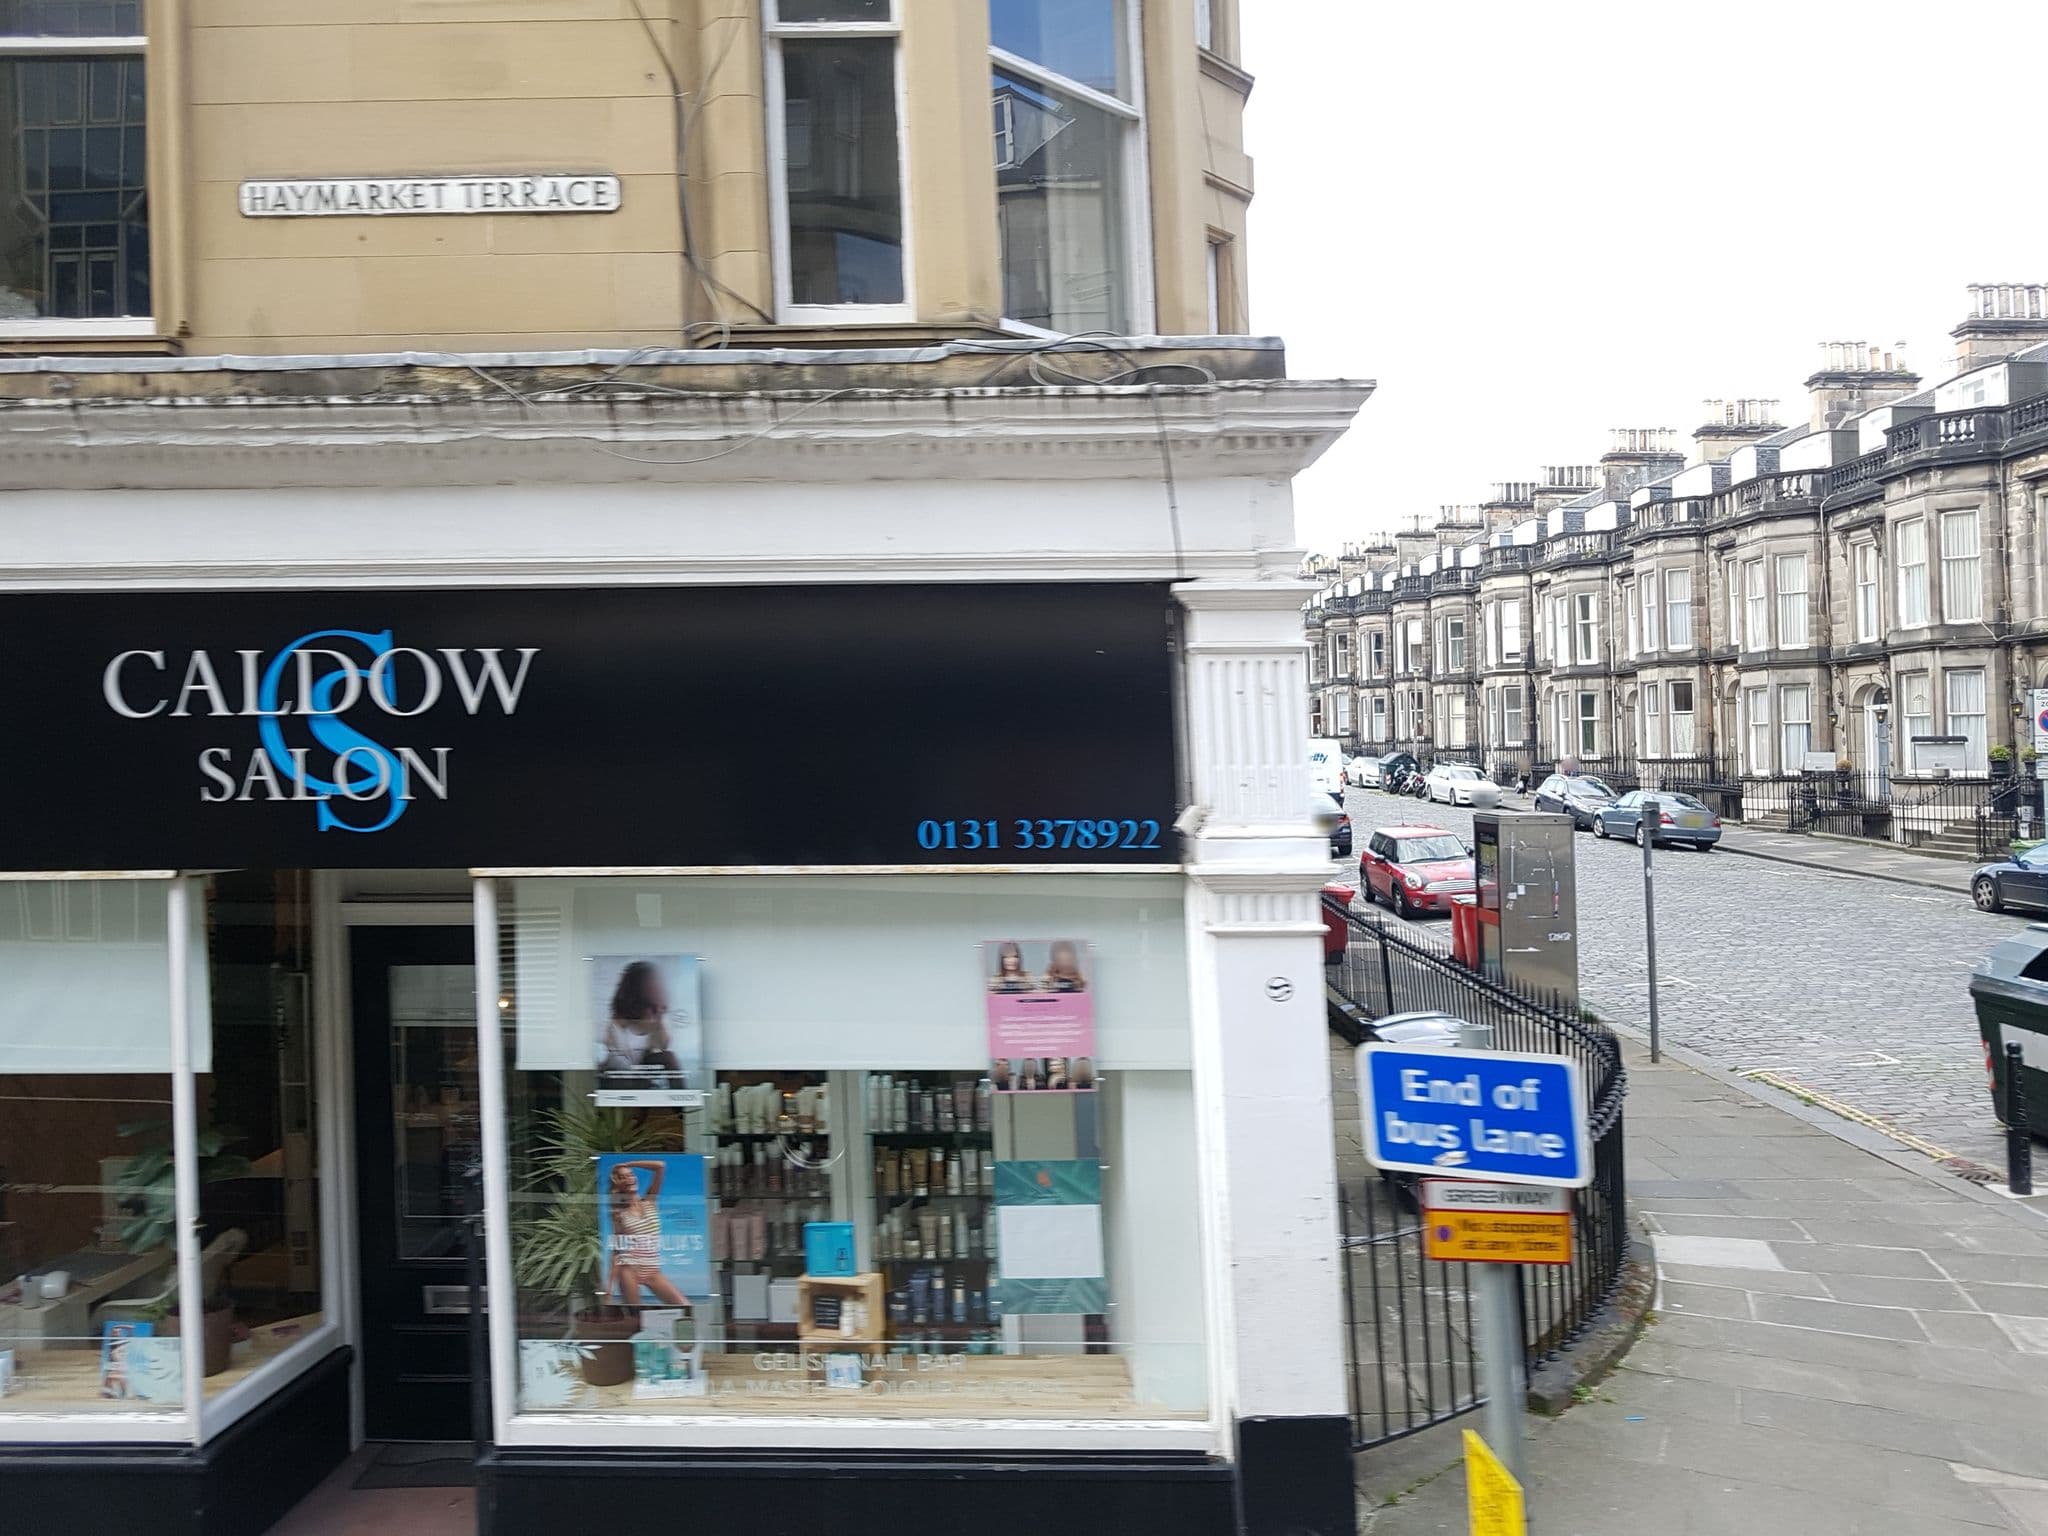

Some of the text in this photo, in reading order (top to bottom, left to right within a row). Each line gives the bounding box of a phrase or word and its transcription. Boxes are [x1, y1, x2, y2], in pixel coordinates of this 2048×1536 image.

[247, 180, 612, 212] HAYMARKET TERRACE
[102, 647, 542, 719] CALDOW
[198, 747, 454, 802] SALON
[916, 819, 1162, 850] 0131 3378922
[1400, 1068, 1542, 1112] End of
[1384, 1111, 1567, 1158] bus lane
